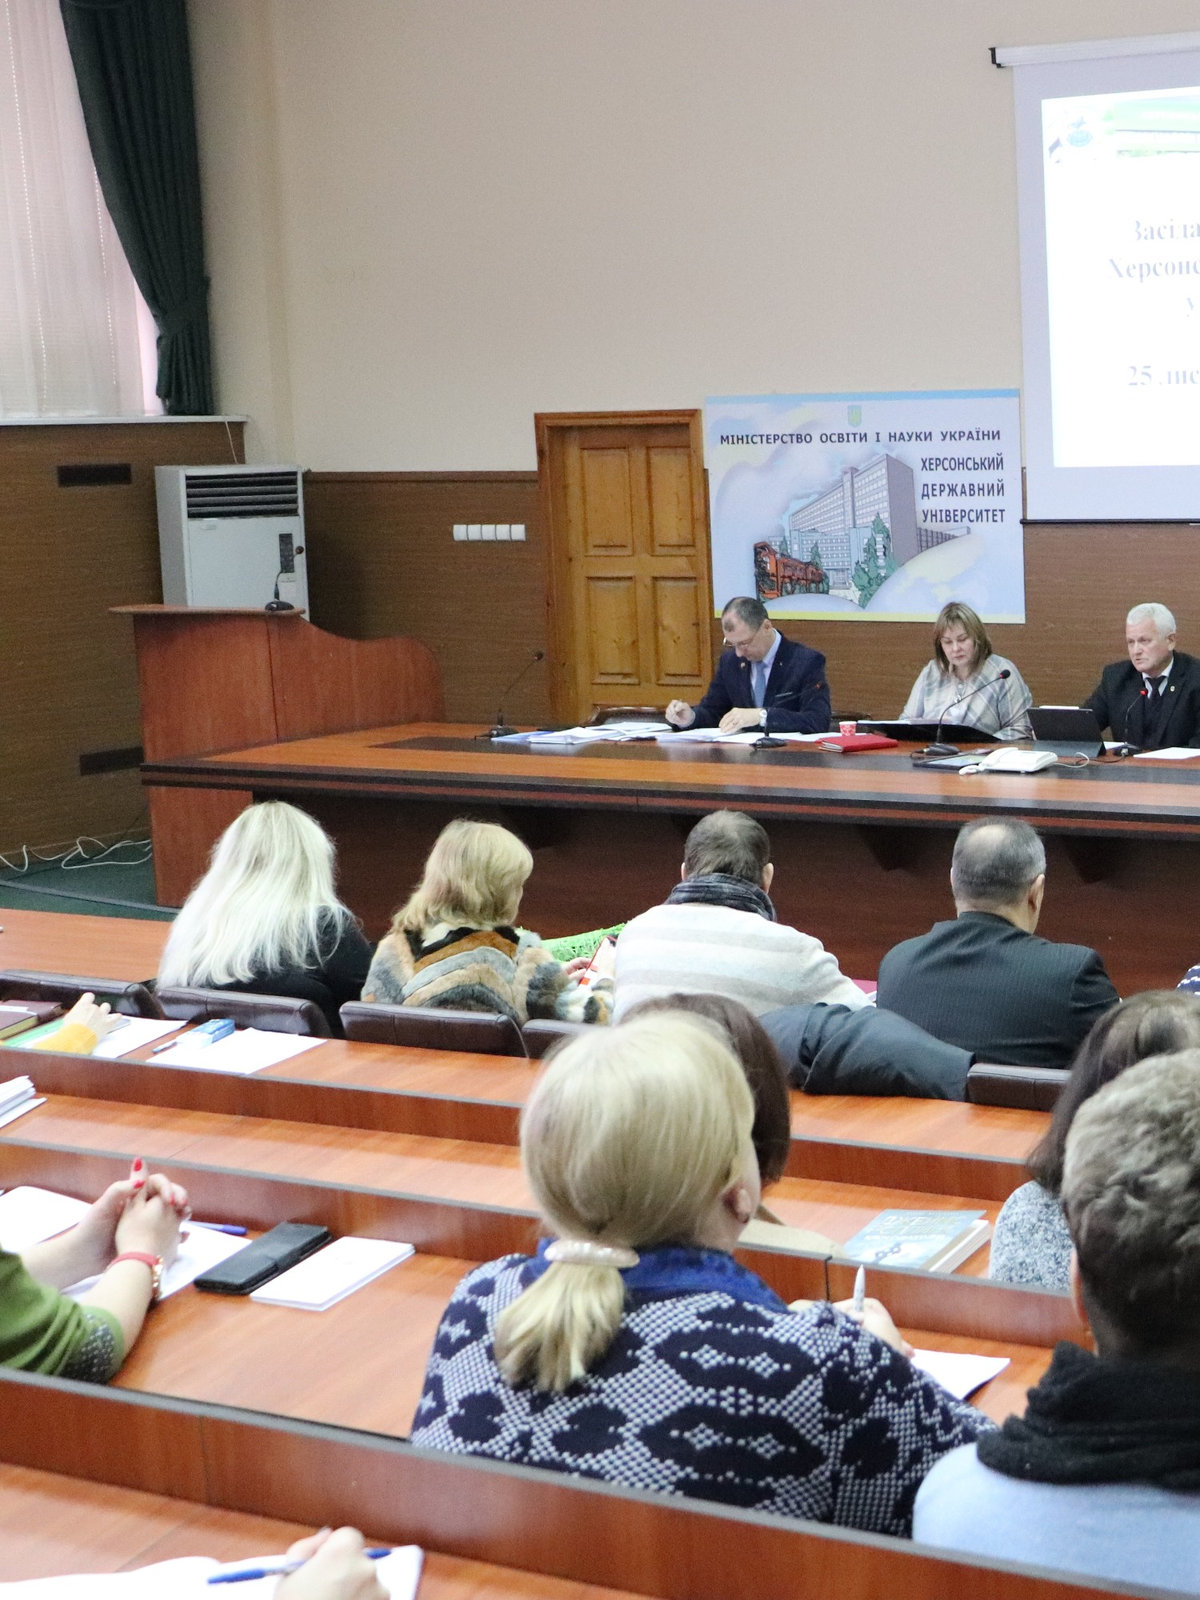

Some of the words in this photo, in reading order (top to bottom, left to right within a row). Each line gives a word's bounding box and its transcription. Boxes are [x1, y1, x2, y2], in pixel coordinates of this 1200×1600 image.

[1127, 364, 1153, 387] 25
[719, 431, 814, 446] МІНІСТЕРСТВО
[819, 430, 869, 445] ОСВІТИ
[874, 430, 882, 443] І
[888, 430, 934, 443] НАУКИ
[939, 427, 1002, 442] УКРАЇНИ
[920, 452, 1005, 473] ХЕРСОНСЬКИЙ
[921, 478, 1006, 500] ДЕРЖАВНИЙ
[921, 508, 1007, 524] УНІВЕРСИТЕТ
